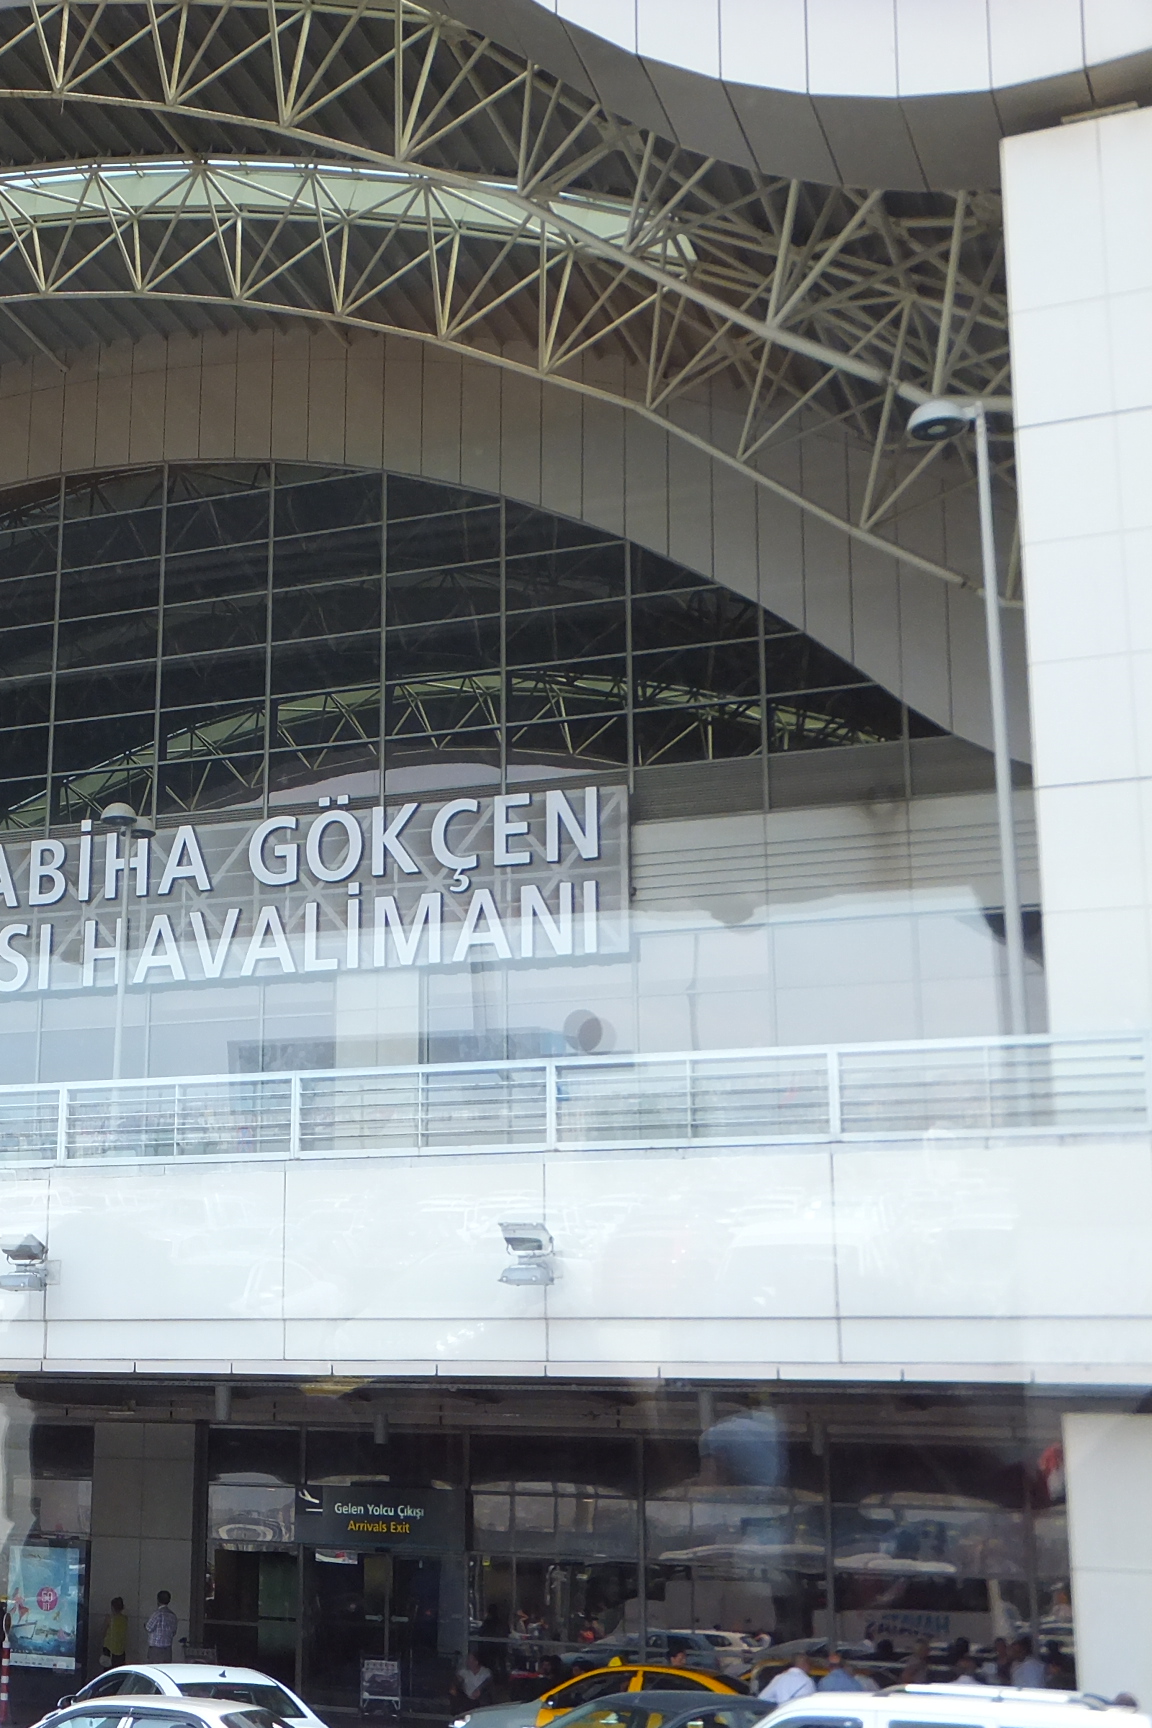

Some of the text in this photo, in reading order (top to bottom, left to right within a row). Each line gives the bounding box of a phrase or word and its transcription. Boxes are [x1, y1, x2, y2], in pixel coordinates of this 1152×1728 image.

[248, 787, 599, 893] GÖKÇEN
[83, 880, 598, 987] HAVALİMANI
[334, 1503, 425, 1520] Gelen Yolcu Çıkışı
[347, 1520, 410, 1533] Arrivals Exit
